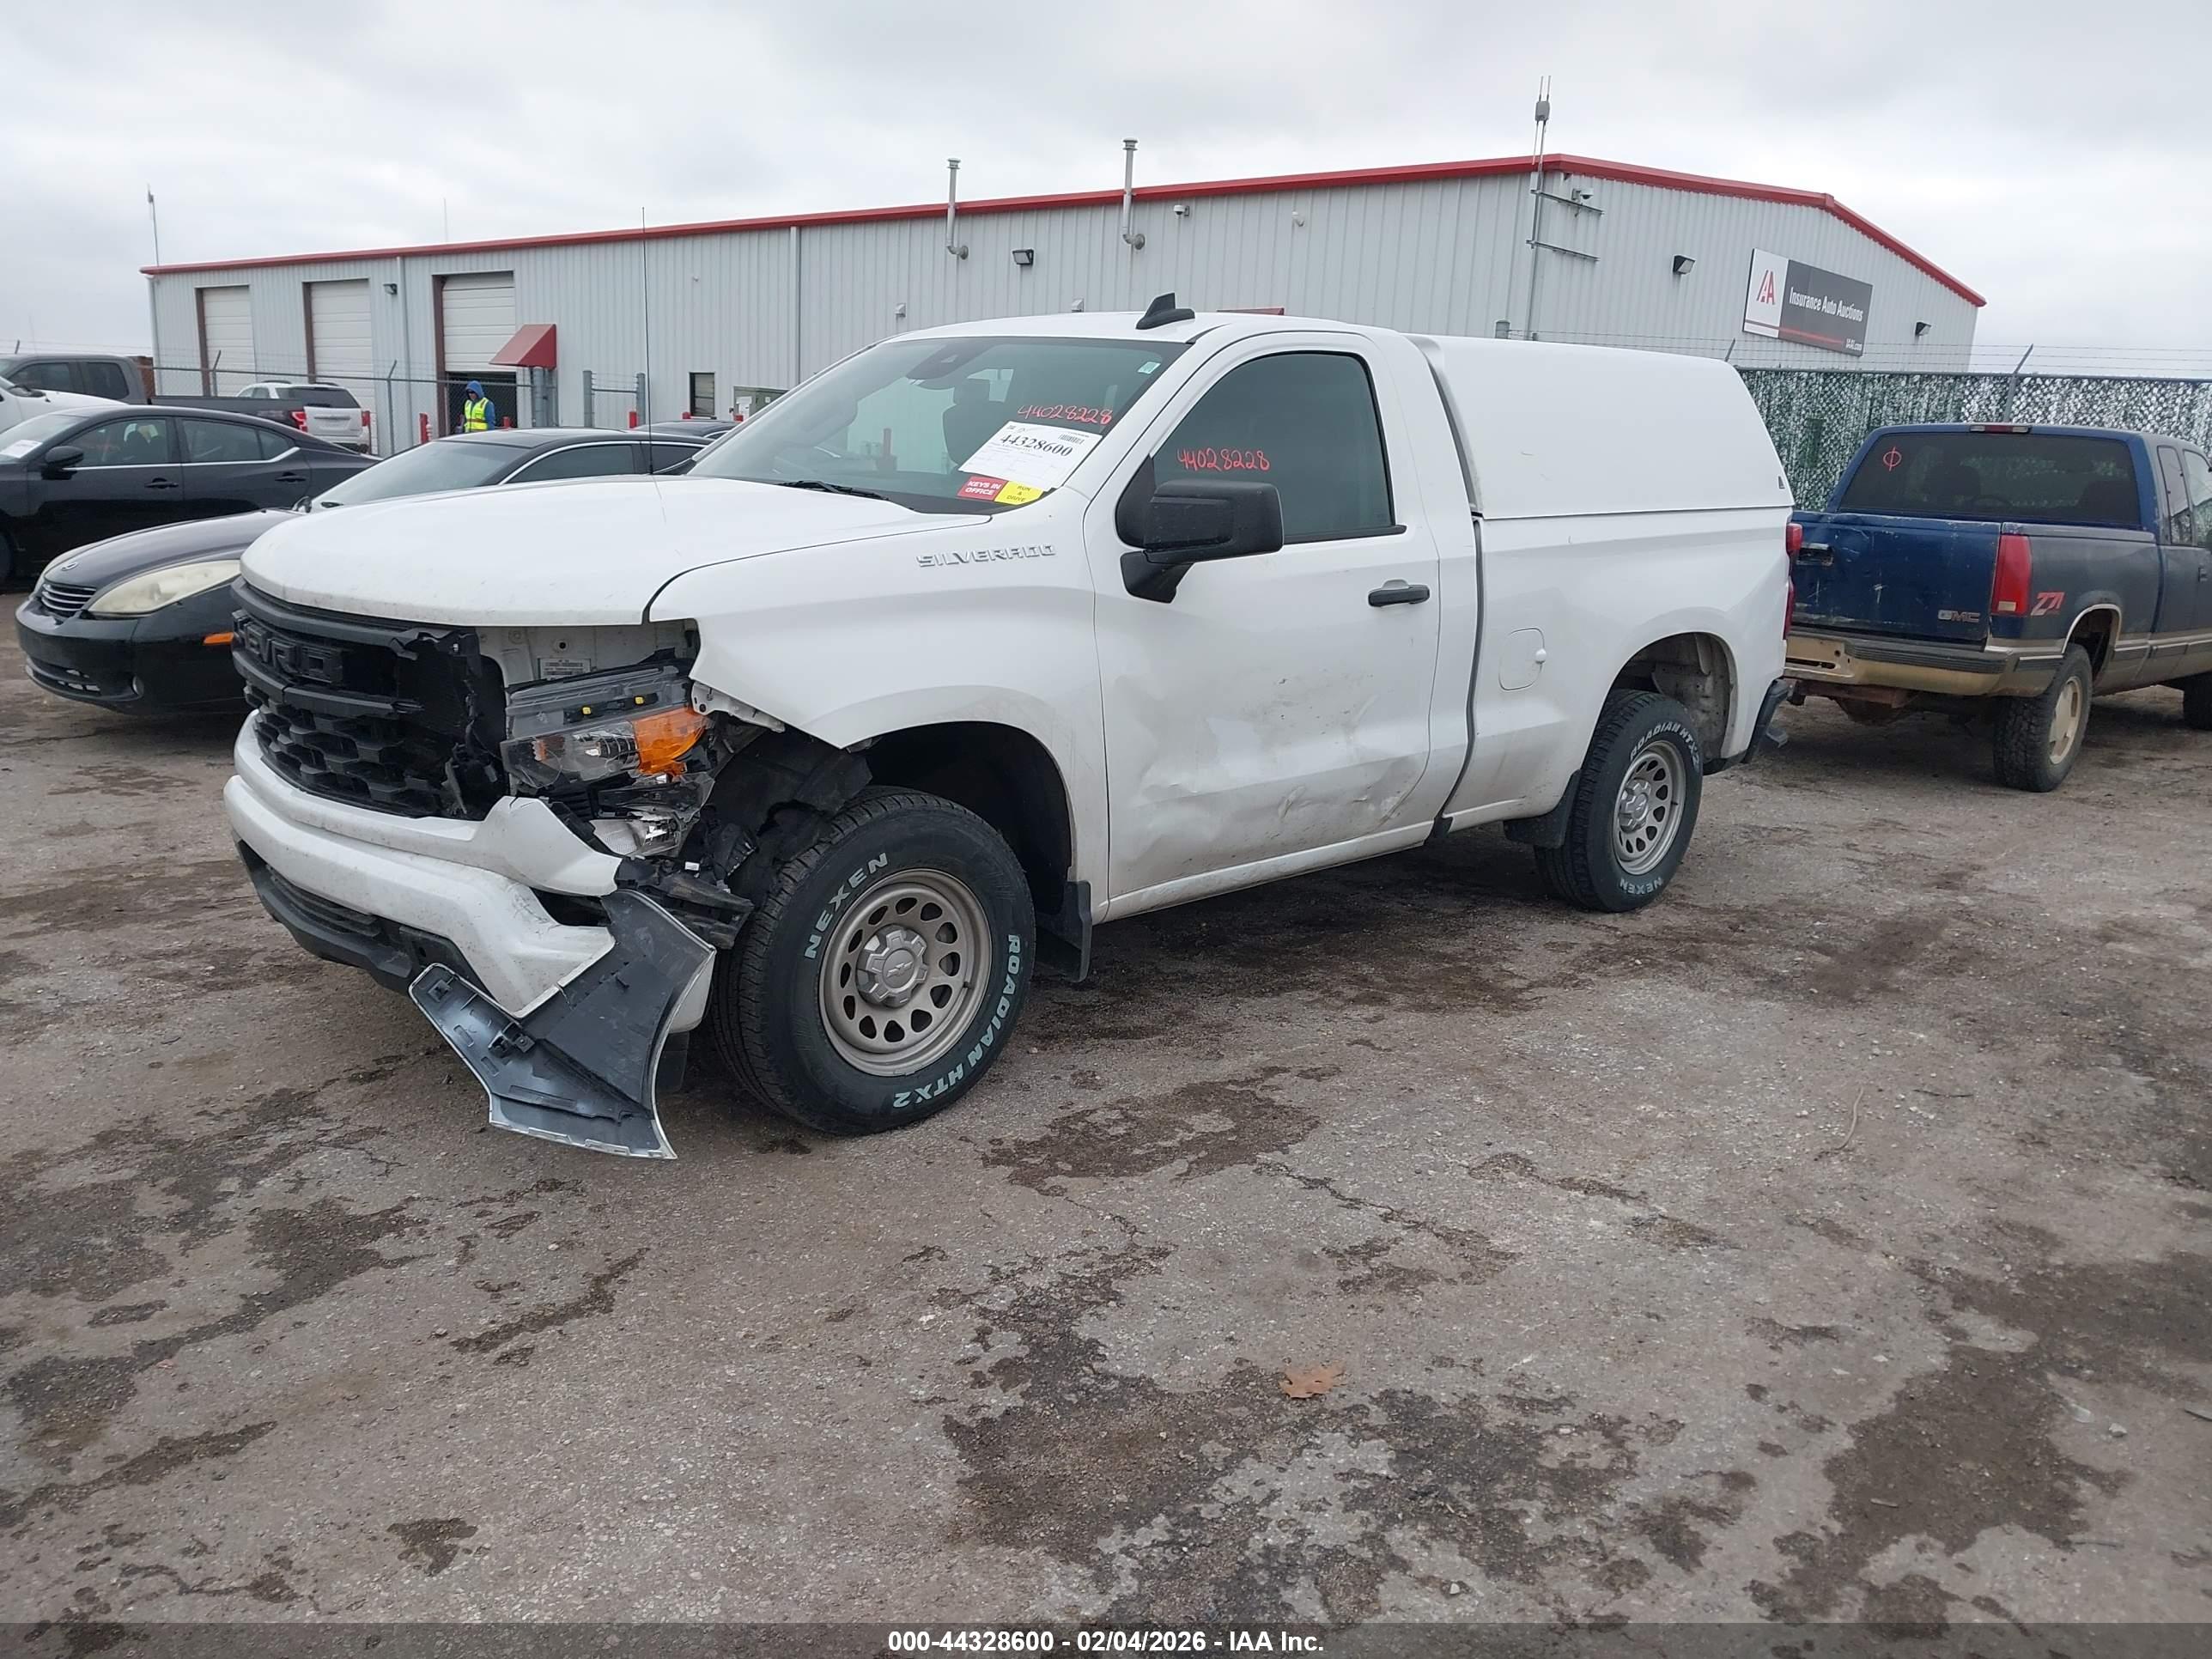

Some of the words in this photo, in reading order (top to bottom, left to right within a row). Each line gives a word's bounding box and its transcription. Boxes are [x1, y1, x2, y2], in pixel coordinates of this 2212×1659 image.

[1789, 287, 1821, 311] Insurance
[1821, 295, 1837, 316] Auto
[1837, 301, 1863, 322] Auctions
[1017, 404, 1113, 425] 44028228
[1000, 434, 1073, 458] 44328600
[1176, 447, 1271, 472] 44028228
[965, 487, 995, 496] OFFICE
[967, 480, 989, 489] KEYS
[915, 544, 1058, 568] SILVERADO
[1937, 609, 1981, 623] GMC
[2030, 592, 2065, 616] Z71
[1630, 721, 1681, 763] ROADIAN
[1680, 727, 1700, 767] HTX2
[1620, 876, 1663, 895] NEXEN
[805, 852, 889, 960] NEXEN
[967, 933, 1022, 1067] ROADIAN
[892, 1061, 964, 1109] HTX2
